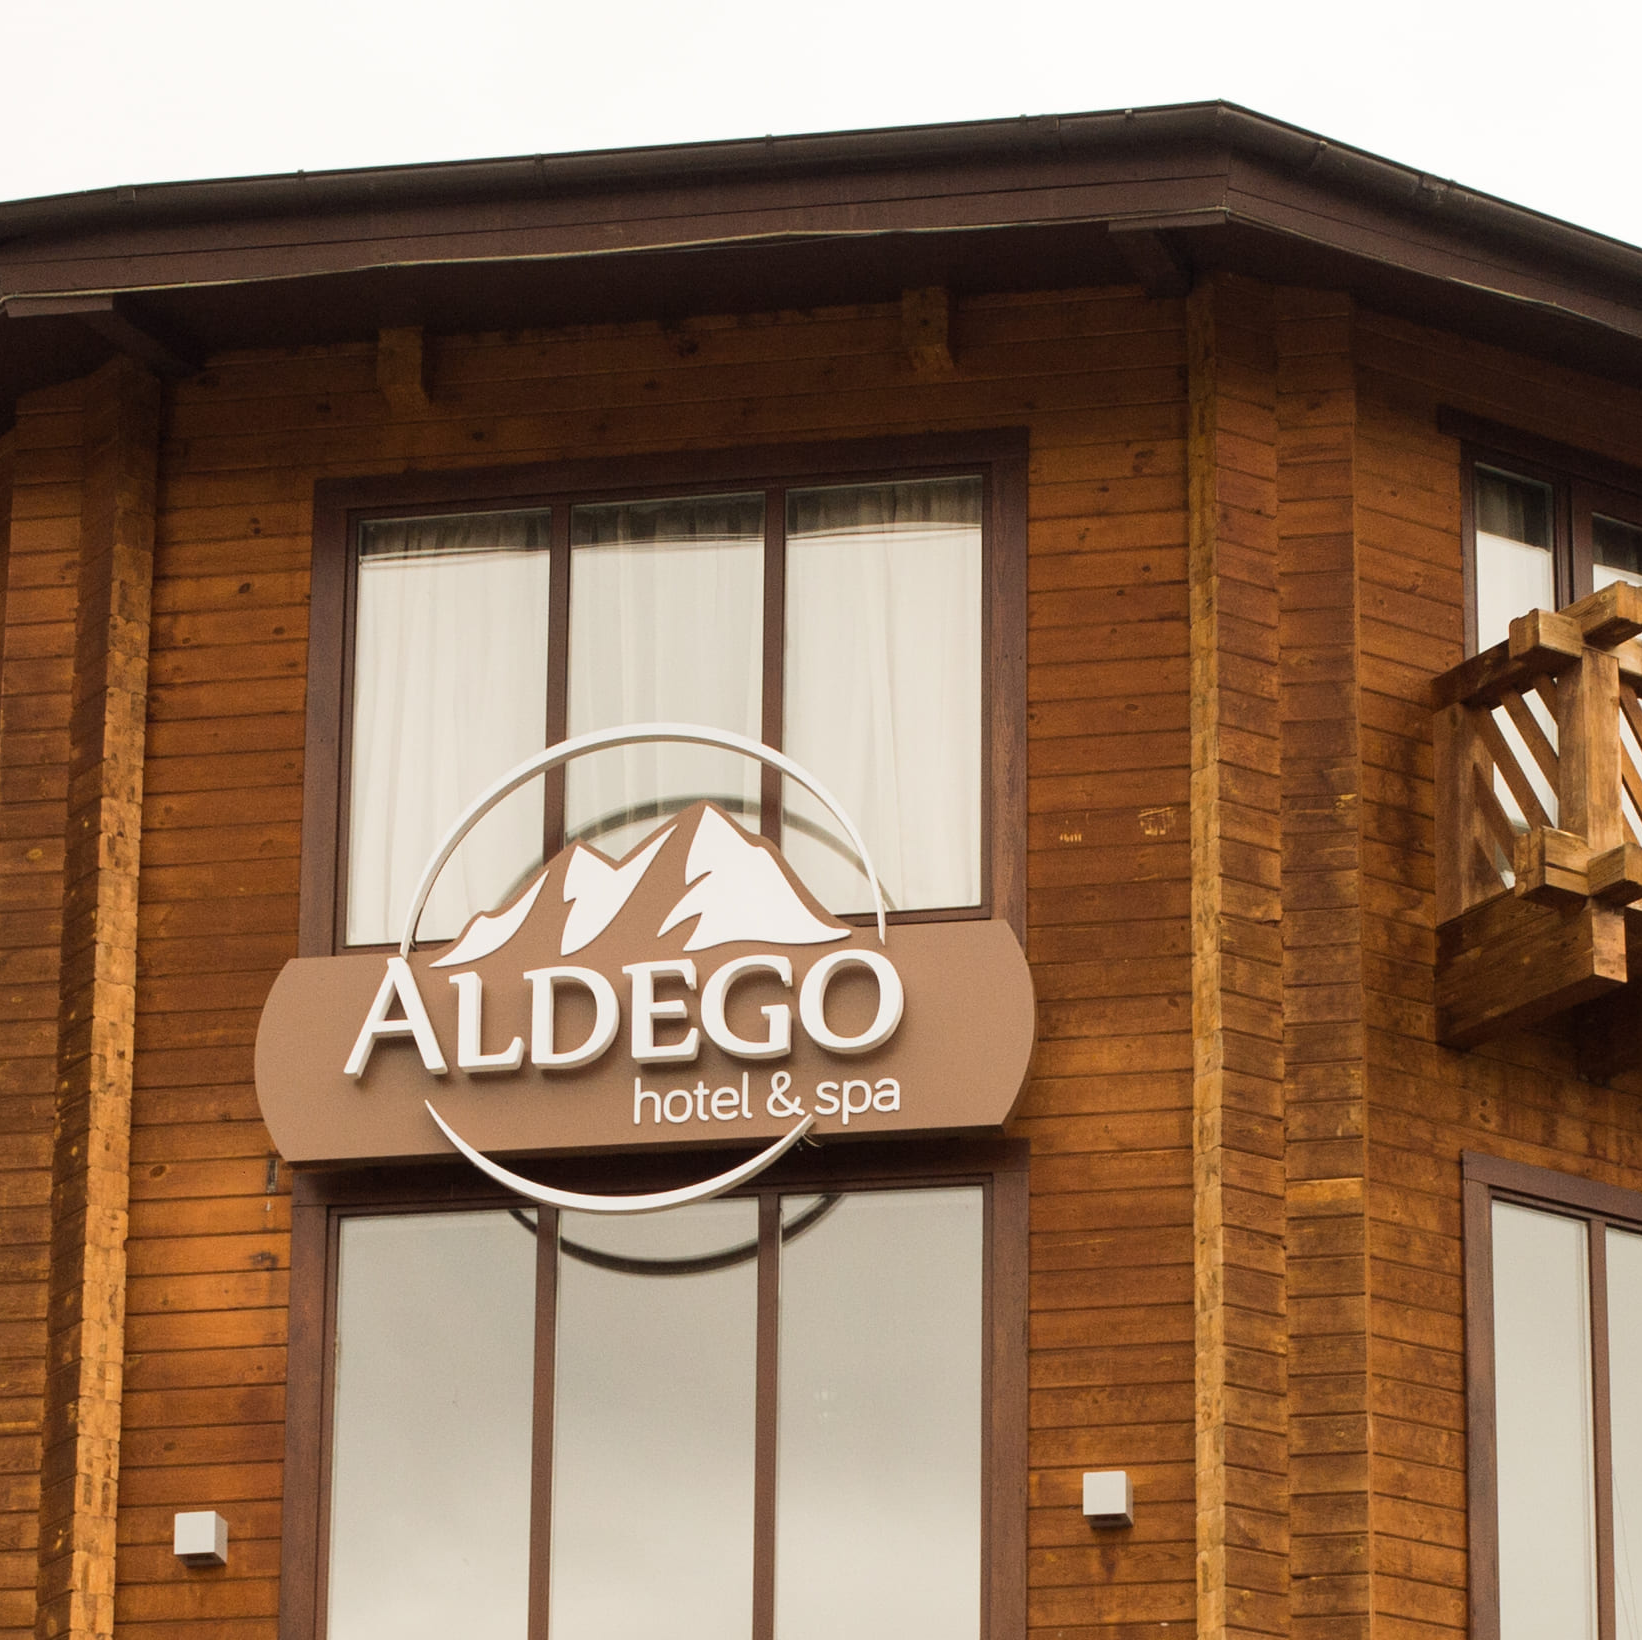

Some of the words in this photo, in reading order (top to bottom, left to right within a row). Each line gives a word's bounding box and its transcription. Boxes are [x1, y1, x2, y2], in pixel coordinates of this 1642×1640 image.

[343, 949, 905, 1079] ALDEGO
[633, 1071, 753, 1125] hotel
[766, 1070, 806, 1118] &
[814, 1077, 901, 1125] spa
